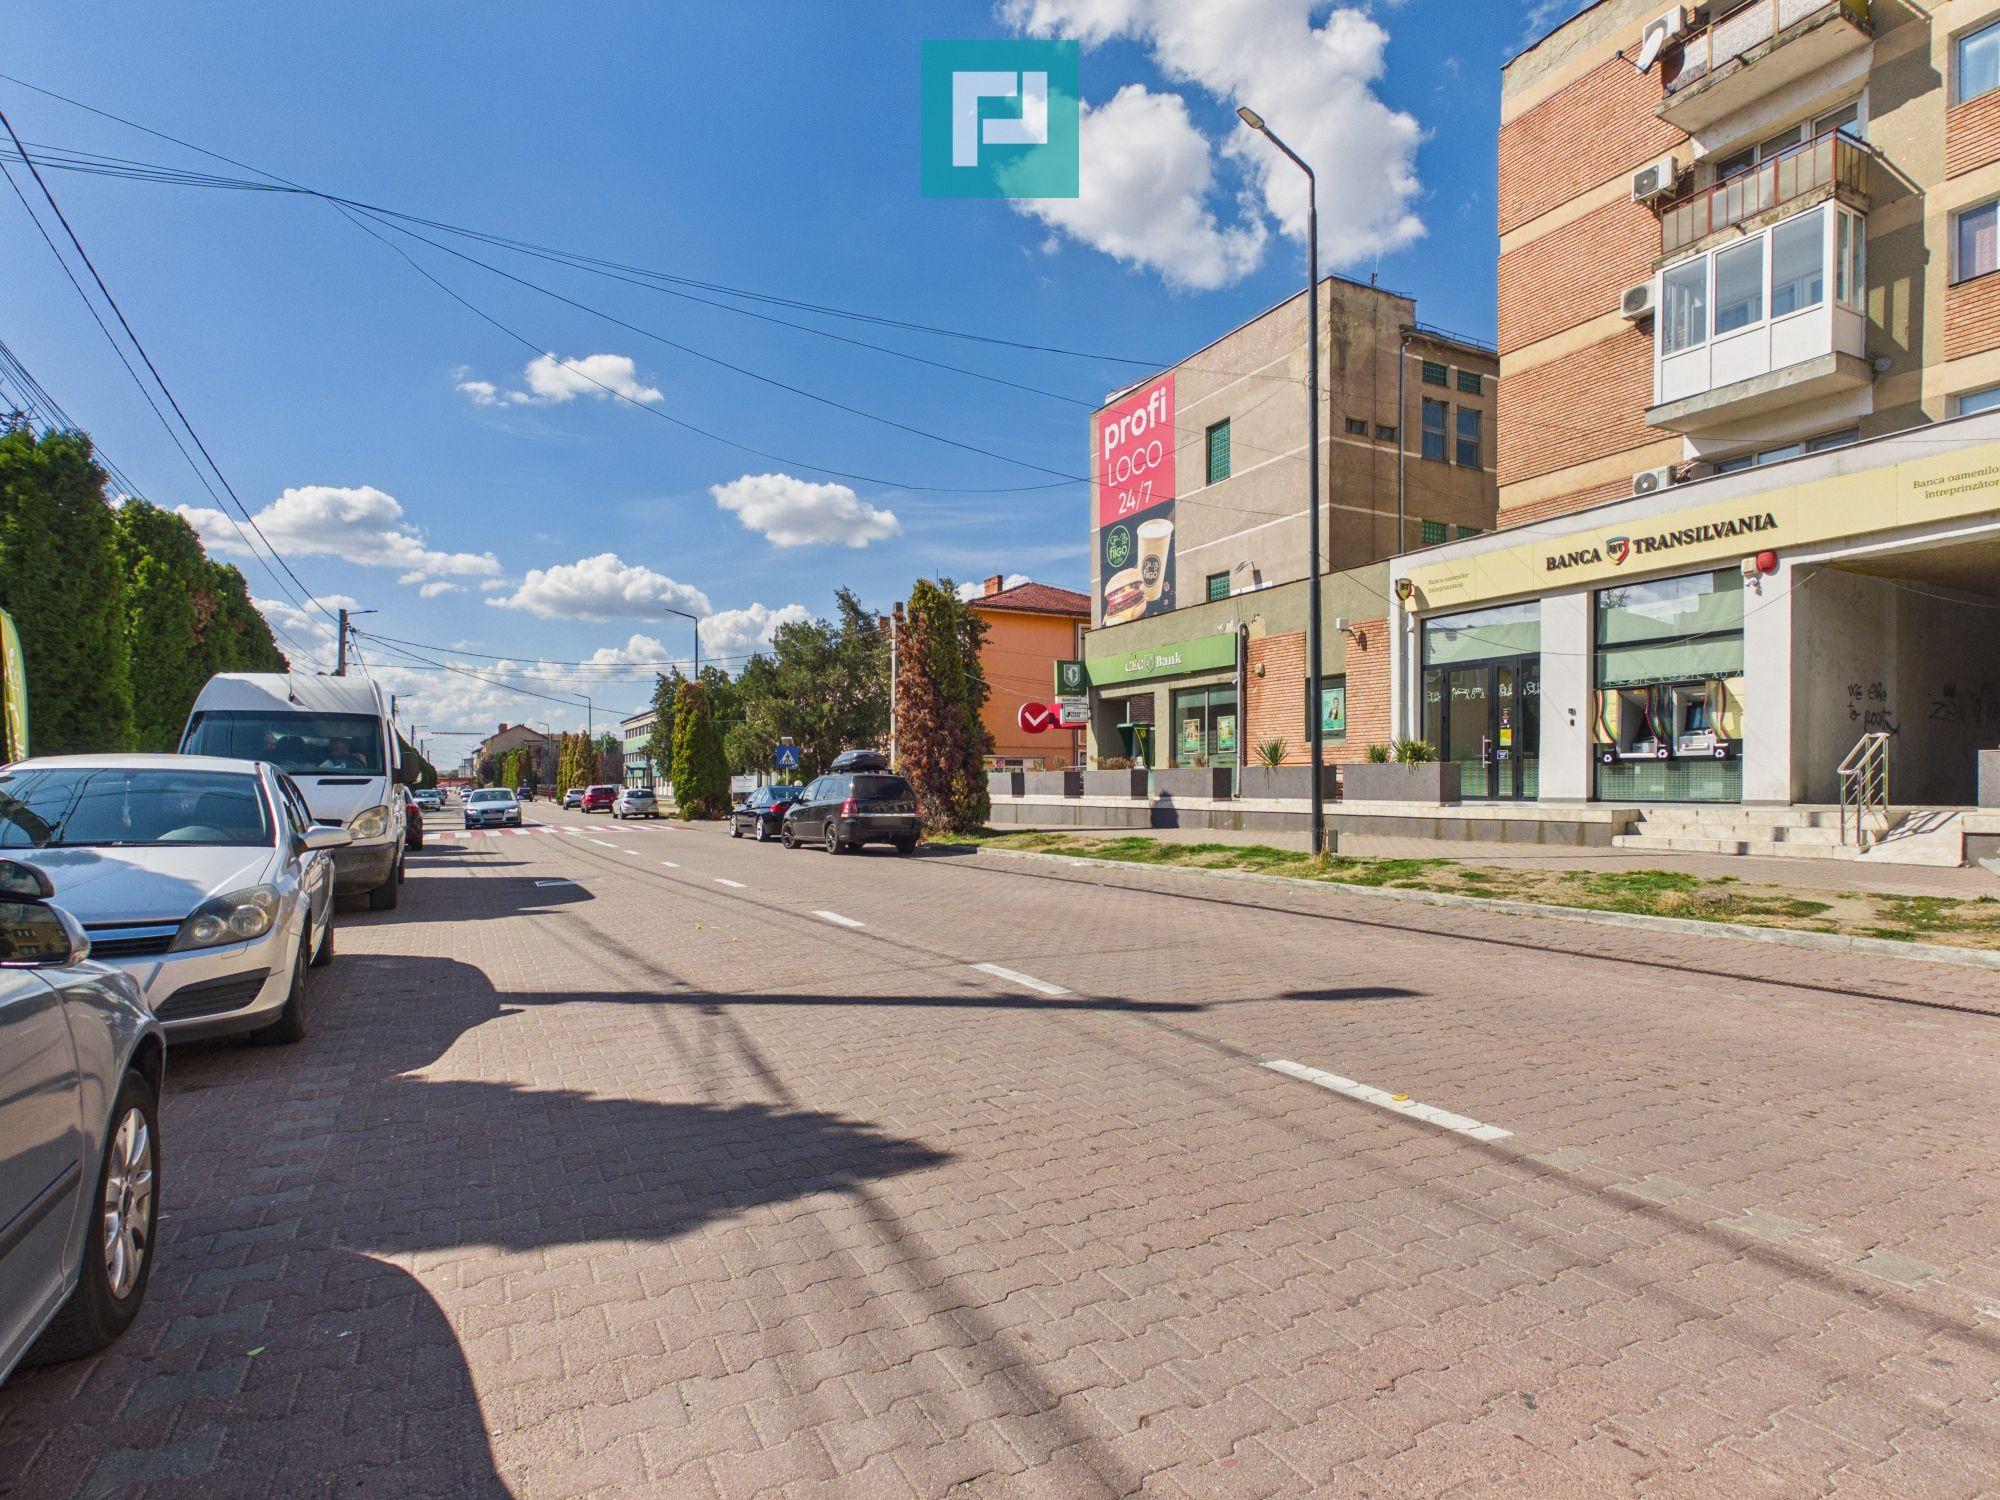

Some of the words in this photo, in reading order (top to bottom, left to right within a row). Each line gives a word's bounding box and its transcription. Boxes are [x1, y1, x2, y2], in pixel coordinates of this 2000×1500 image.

[1104, 386, 1167, 460] profi
[1108, 440, 1163, 487] LOCO
[1913, 477, 1945, 489] Banca
[1947, 465, 2000, 482] oamenilo
[1118, 480, 1153, 514] 24/7
[1545, 547, 1603, 572] BANCA
[1608, 543, 1623, 554] BT
[1633, 512, 1778, 555] TRANSILVANIA
[1125, 659, 1144, 671] CEC
[1156, 652, 1182, 667] Bank
